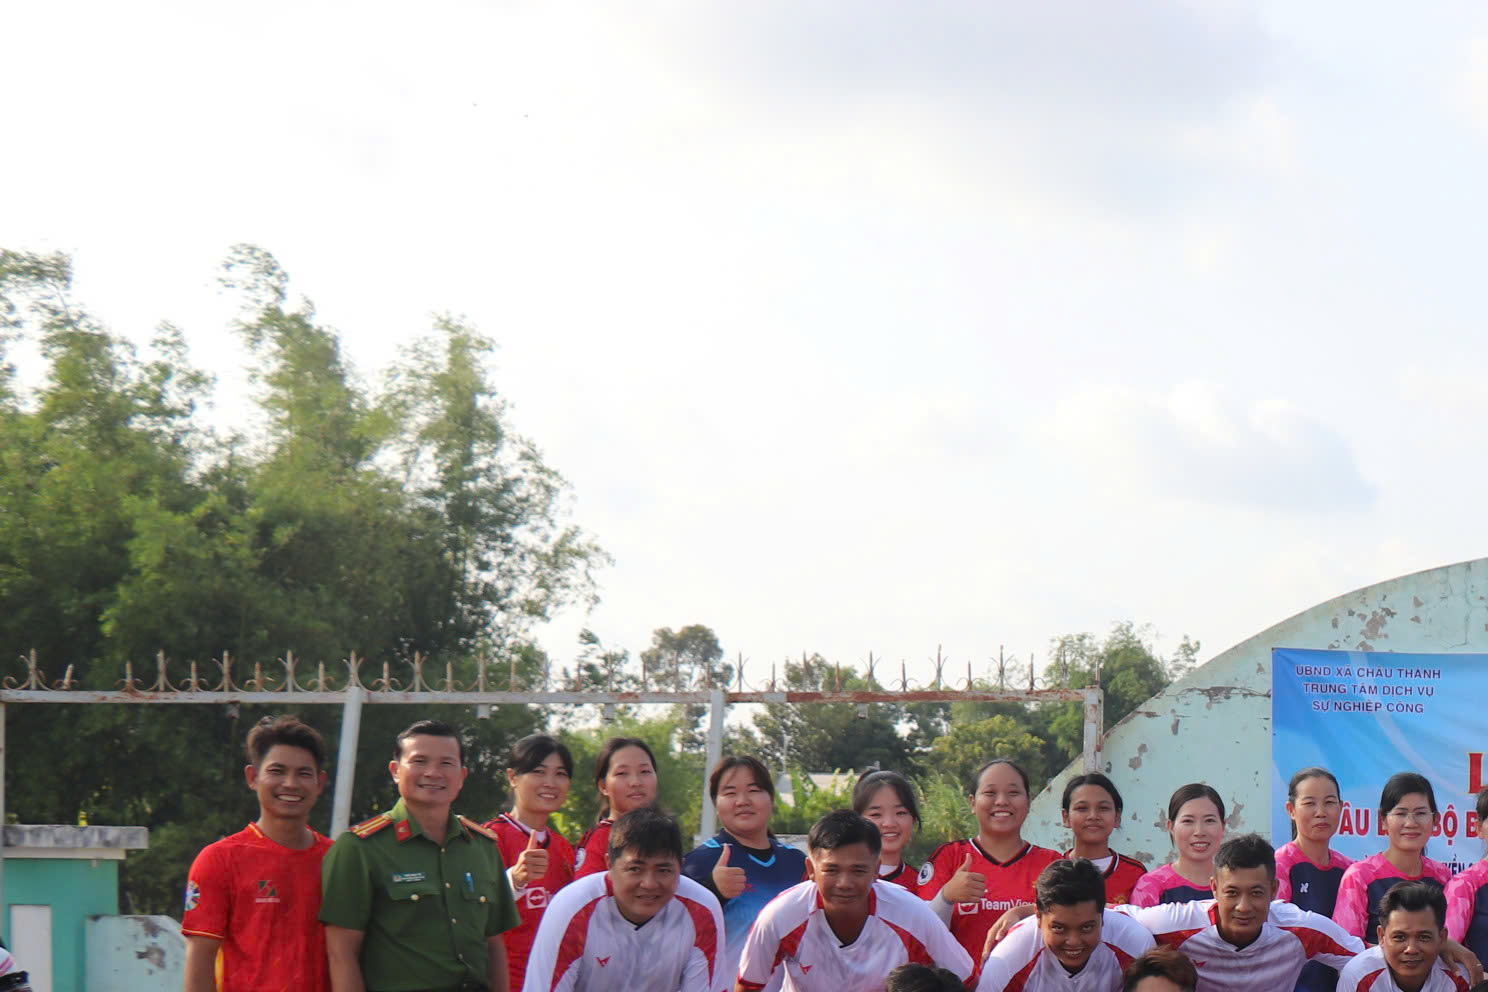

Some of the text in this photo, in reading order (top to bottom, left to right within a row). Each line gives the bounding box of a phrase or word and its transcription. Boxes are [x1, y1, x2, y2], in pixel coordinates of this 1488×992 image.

[1296, 664, 1441, 679] UBND XÃ CHÂU THÀNH
[1304, 682, 1434, 697] TRUNG TÂM DỊCH VỤ
[1312, 700, 1424, 714] SỰ NGHIỆP CÔNG
[1338, 801, 1370, 837] ÂU
